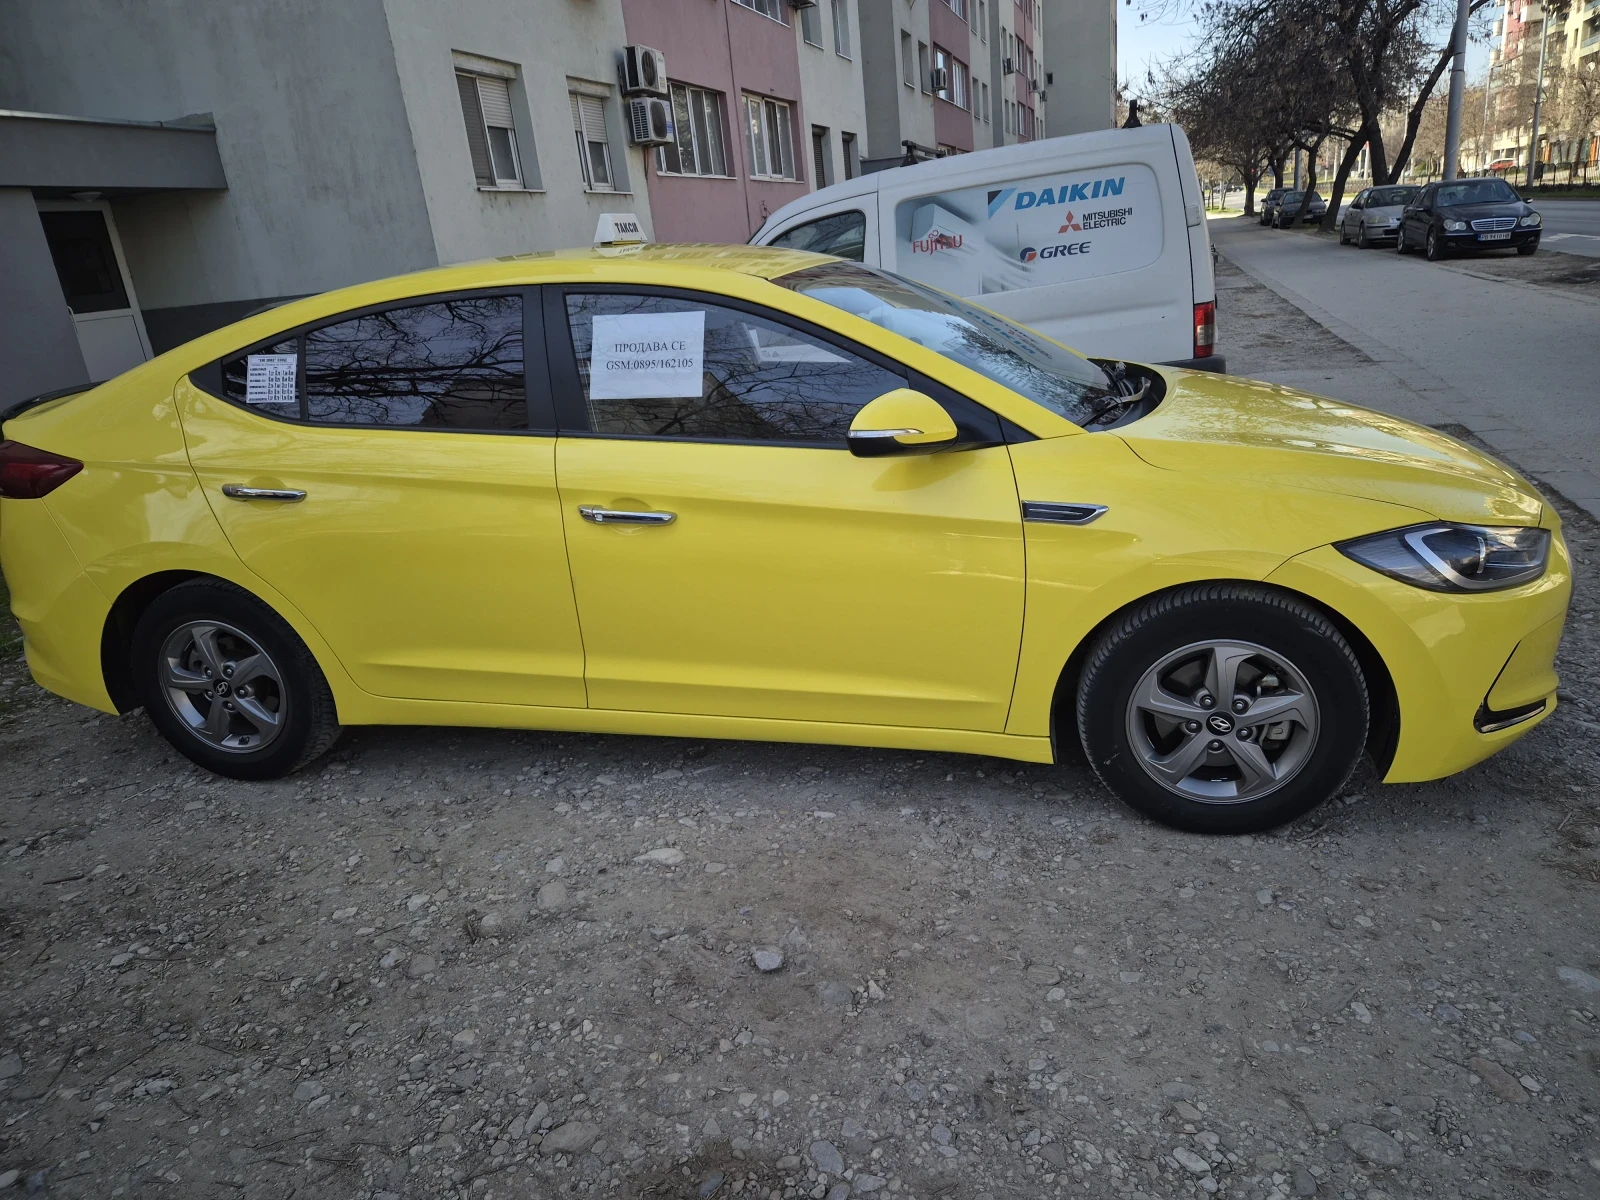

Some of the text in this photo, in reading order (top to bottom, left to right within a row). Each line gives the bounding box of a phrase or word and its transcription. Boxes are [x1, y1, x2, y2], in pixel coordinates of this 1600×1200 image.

[1014, 176, 1126, 211] DAIKIN
[1082, 207, 1133, 222] MITSUBISHI
[614, 222, 640, 234] ТАКСИ
[1083, 216, 1127, 231] ELECTRIC
[912, 230, 963, 255] FUJITSU
[1039, 241, 1092, 259] GREE
[614, 341, 686, 354] ПРОДАВА СЕ
[606, 358, 694, 371] GSM:0895/162105
